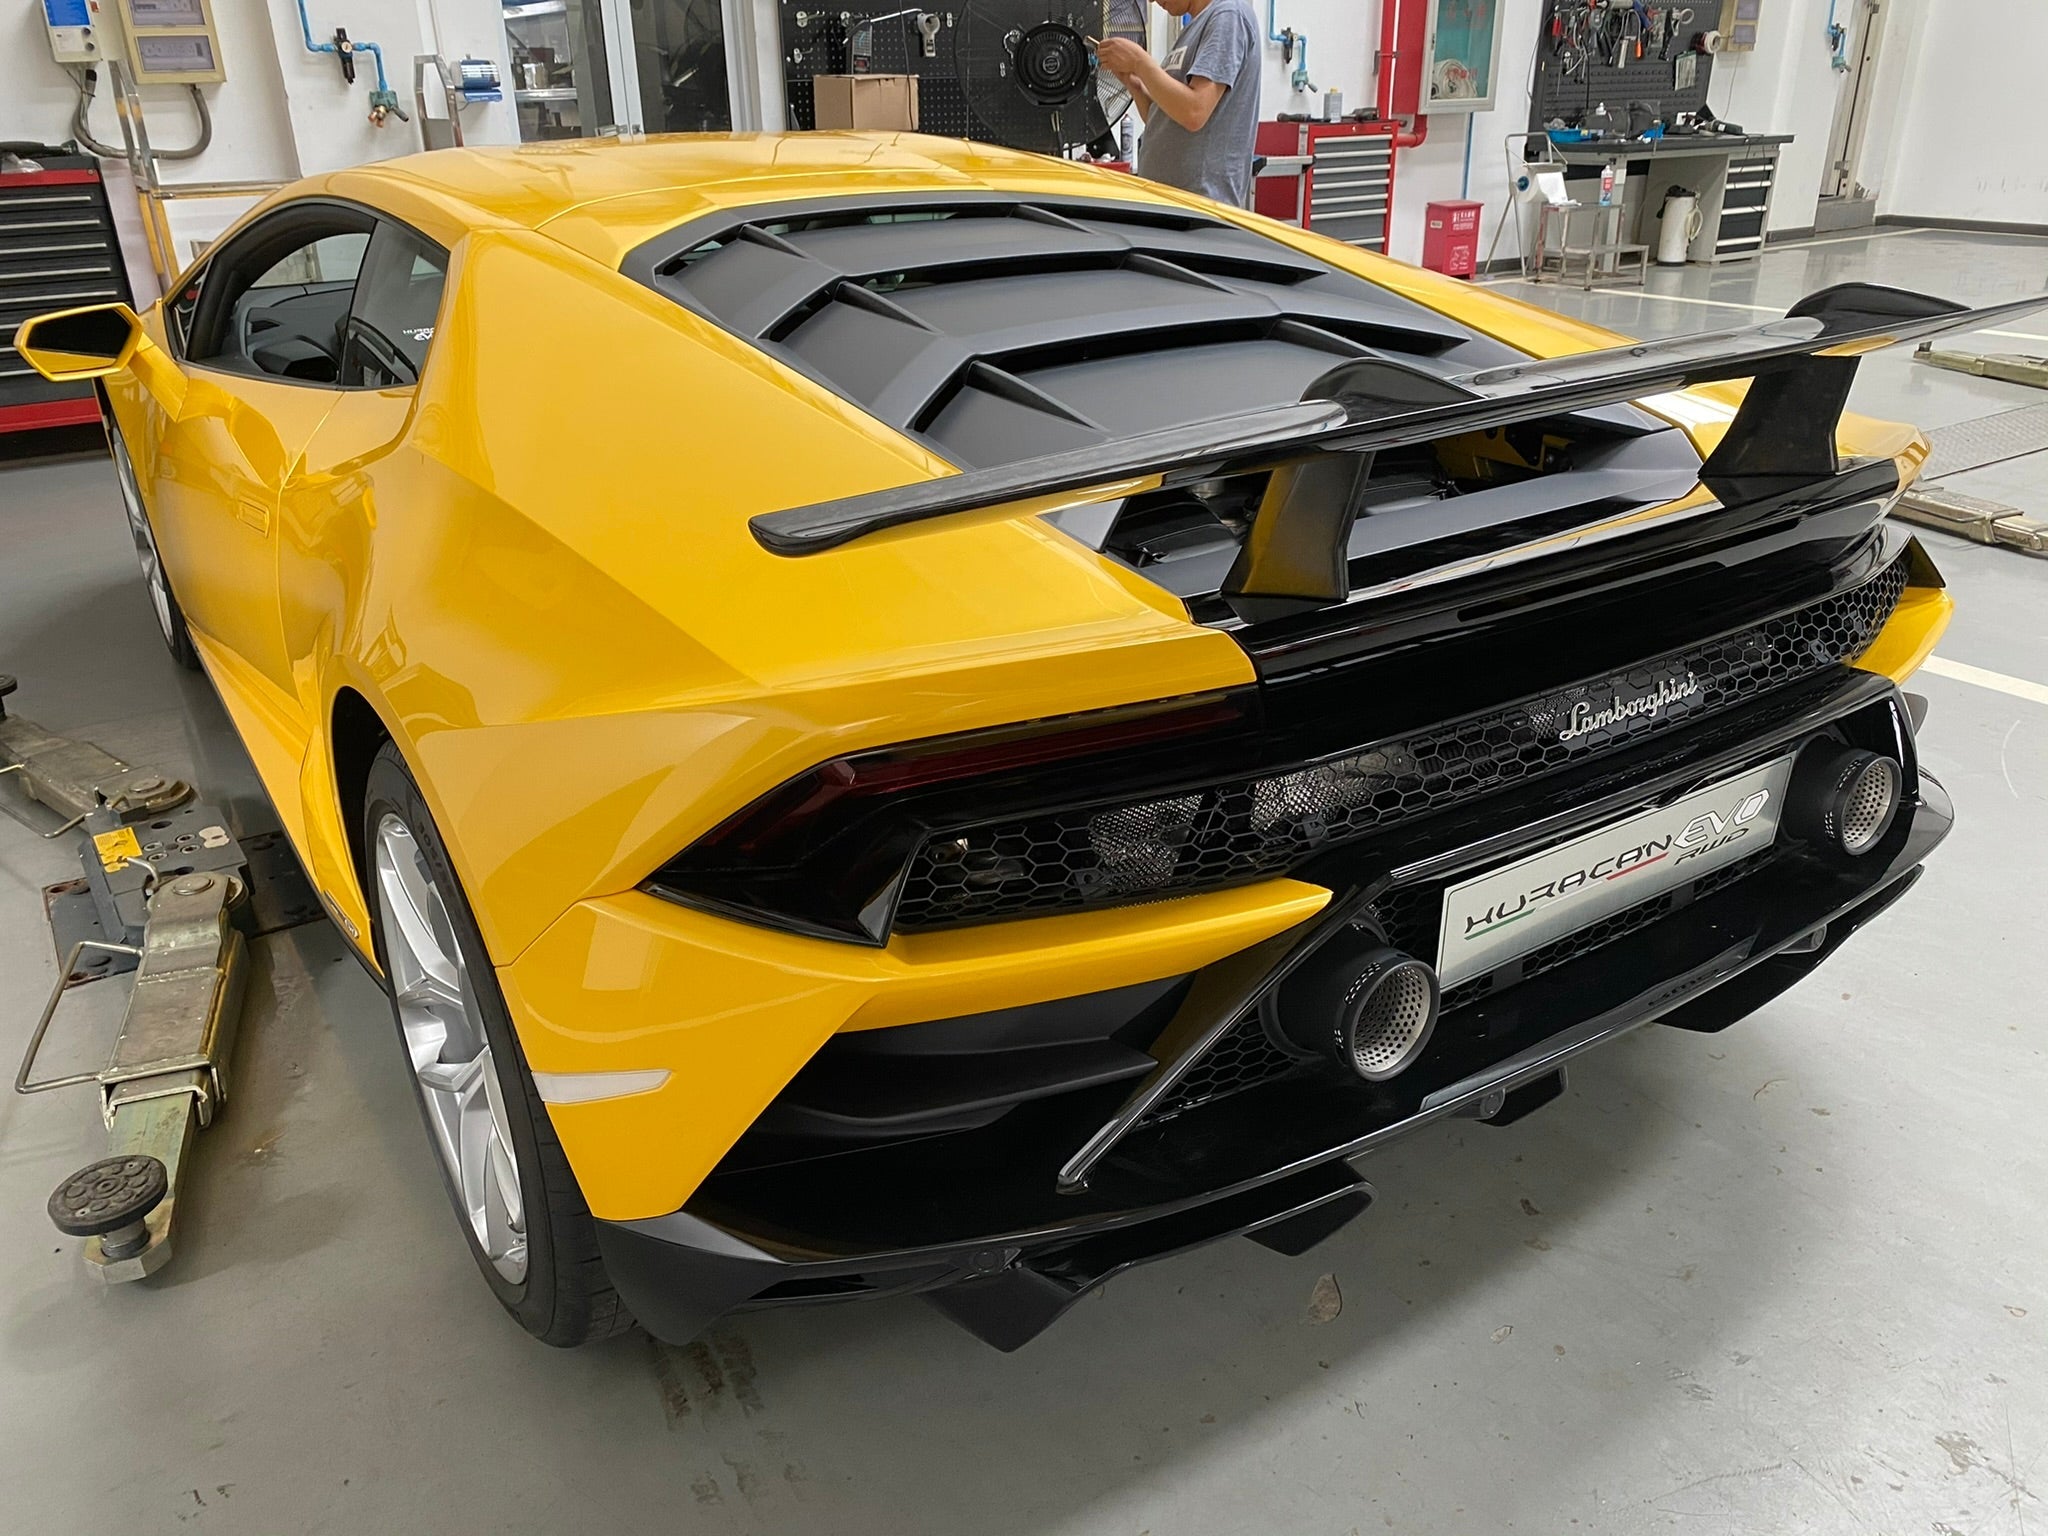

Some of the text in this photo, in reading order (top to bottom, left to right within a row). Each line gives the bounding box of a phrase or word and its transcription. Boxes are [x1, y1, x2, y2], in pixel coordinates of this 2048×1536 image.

[413, 332, 433, 341] EV
[1559, 672, 1698, 741] Lamborghini
[1673, 788, 1770, 849] EVO
[1674, 828, 1749, 867] RWD
